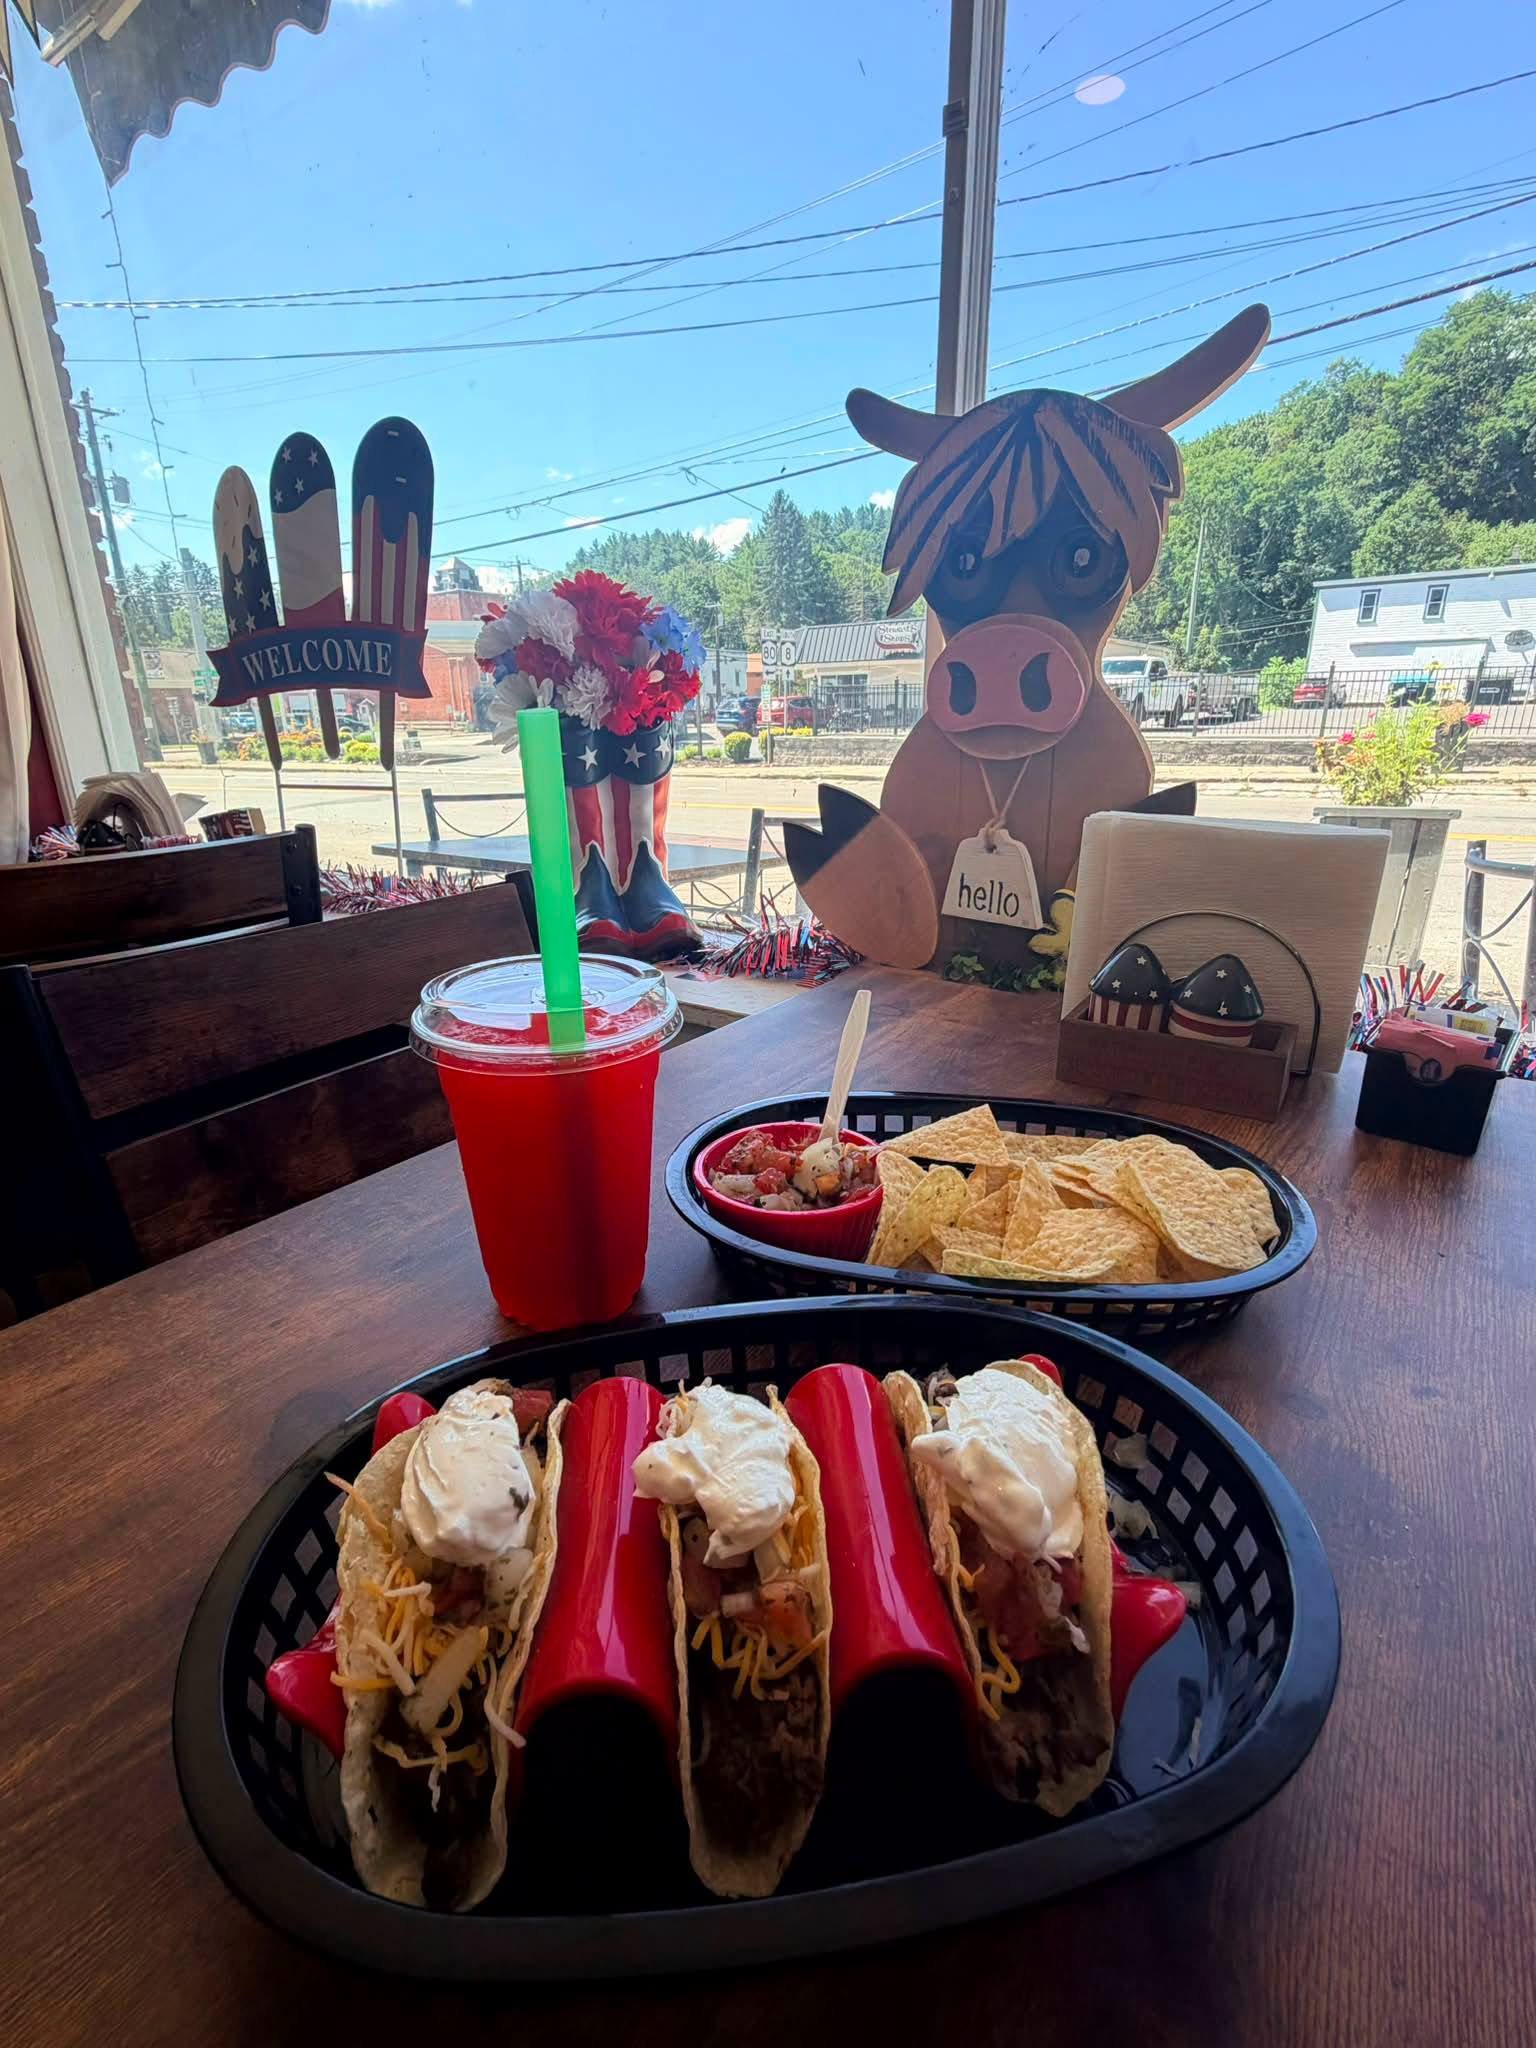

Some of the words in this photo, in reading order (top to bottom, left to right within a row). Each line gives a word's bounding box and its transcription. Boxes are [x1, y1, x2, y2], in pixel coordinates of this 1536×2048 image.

[242, 638, 392, 683] WELCOME
[763, 646, 775, 660] 80
[785, 647, 791, 661] 8
[958, 872, 1020, 918] hello
